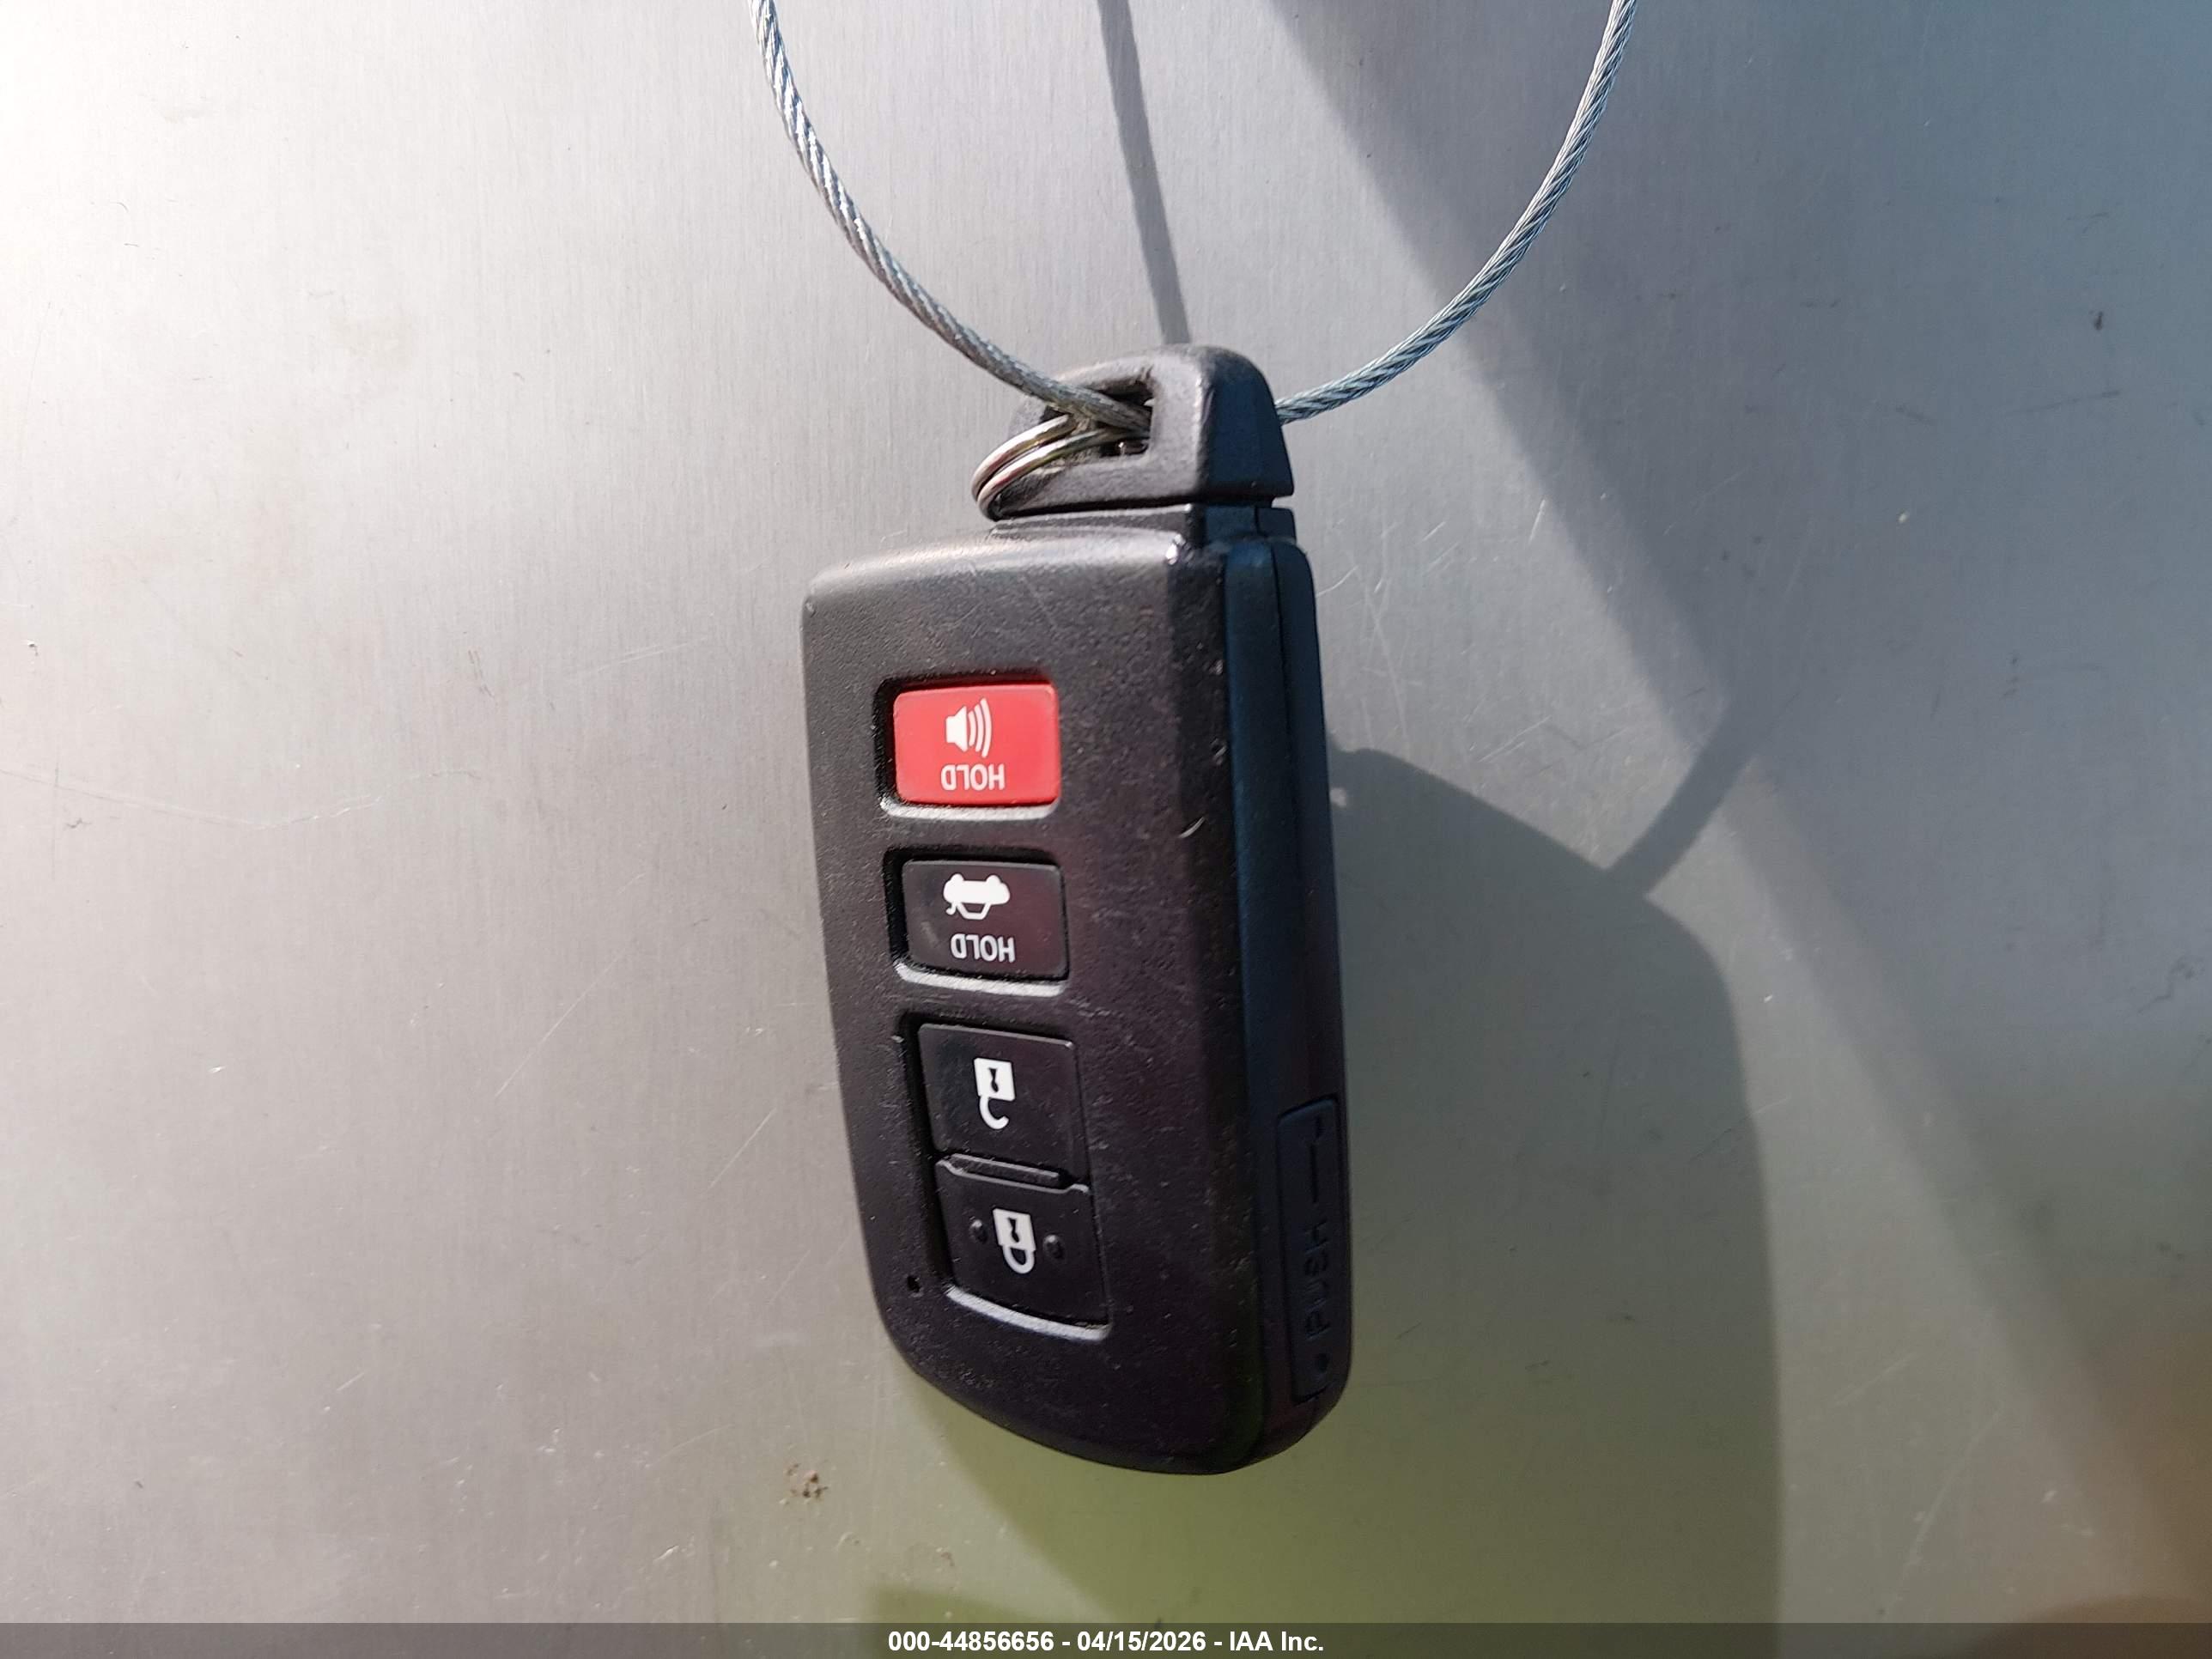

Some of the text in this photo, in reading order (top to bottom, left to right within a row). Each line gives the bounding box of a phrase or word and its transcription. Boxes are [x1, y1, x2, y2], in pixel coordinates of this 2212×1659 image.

[940, 763, 1006, 791] HOLD
[951, 933, 1015, 963] HOLD
[1304, 1219, 1330, 1340] PUSH
